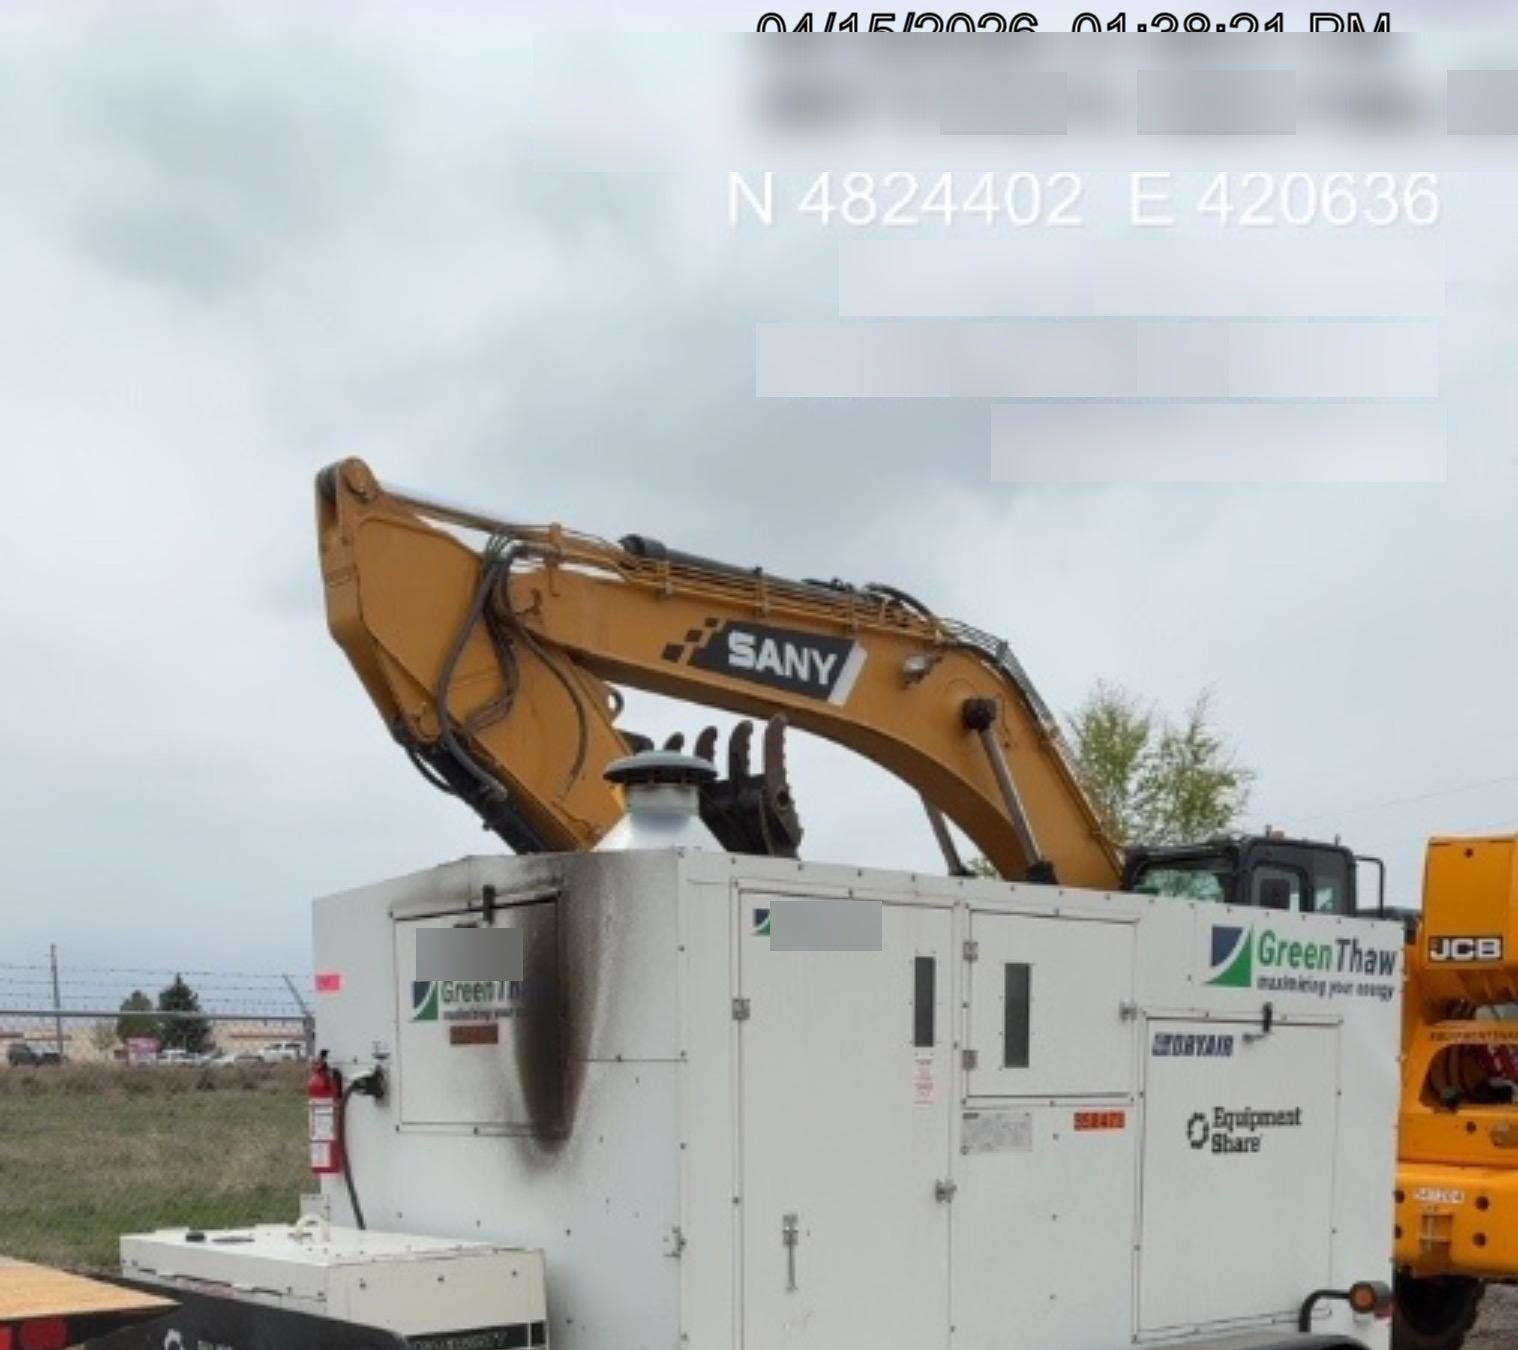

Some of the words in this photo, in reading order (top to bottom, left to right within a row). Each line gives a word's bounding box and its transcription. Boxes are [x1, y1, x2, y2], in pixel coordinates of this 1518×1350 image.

[727, 629, 839, 686] SANY
[1430, 937, 1501, 960] JCB
[1212, 1106, 1303, 1132] Equipment
[1211, 1133, 1261, 1155] Share
